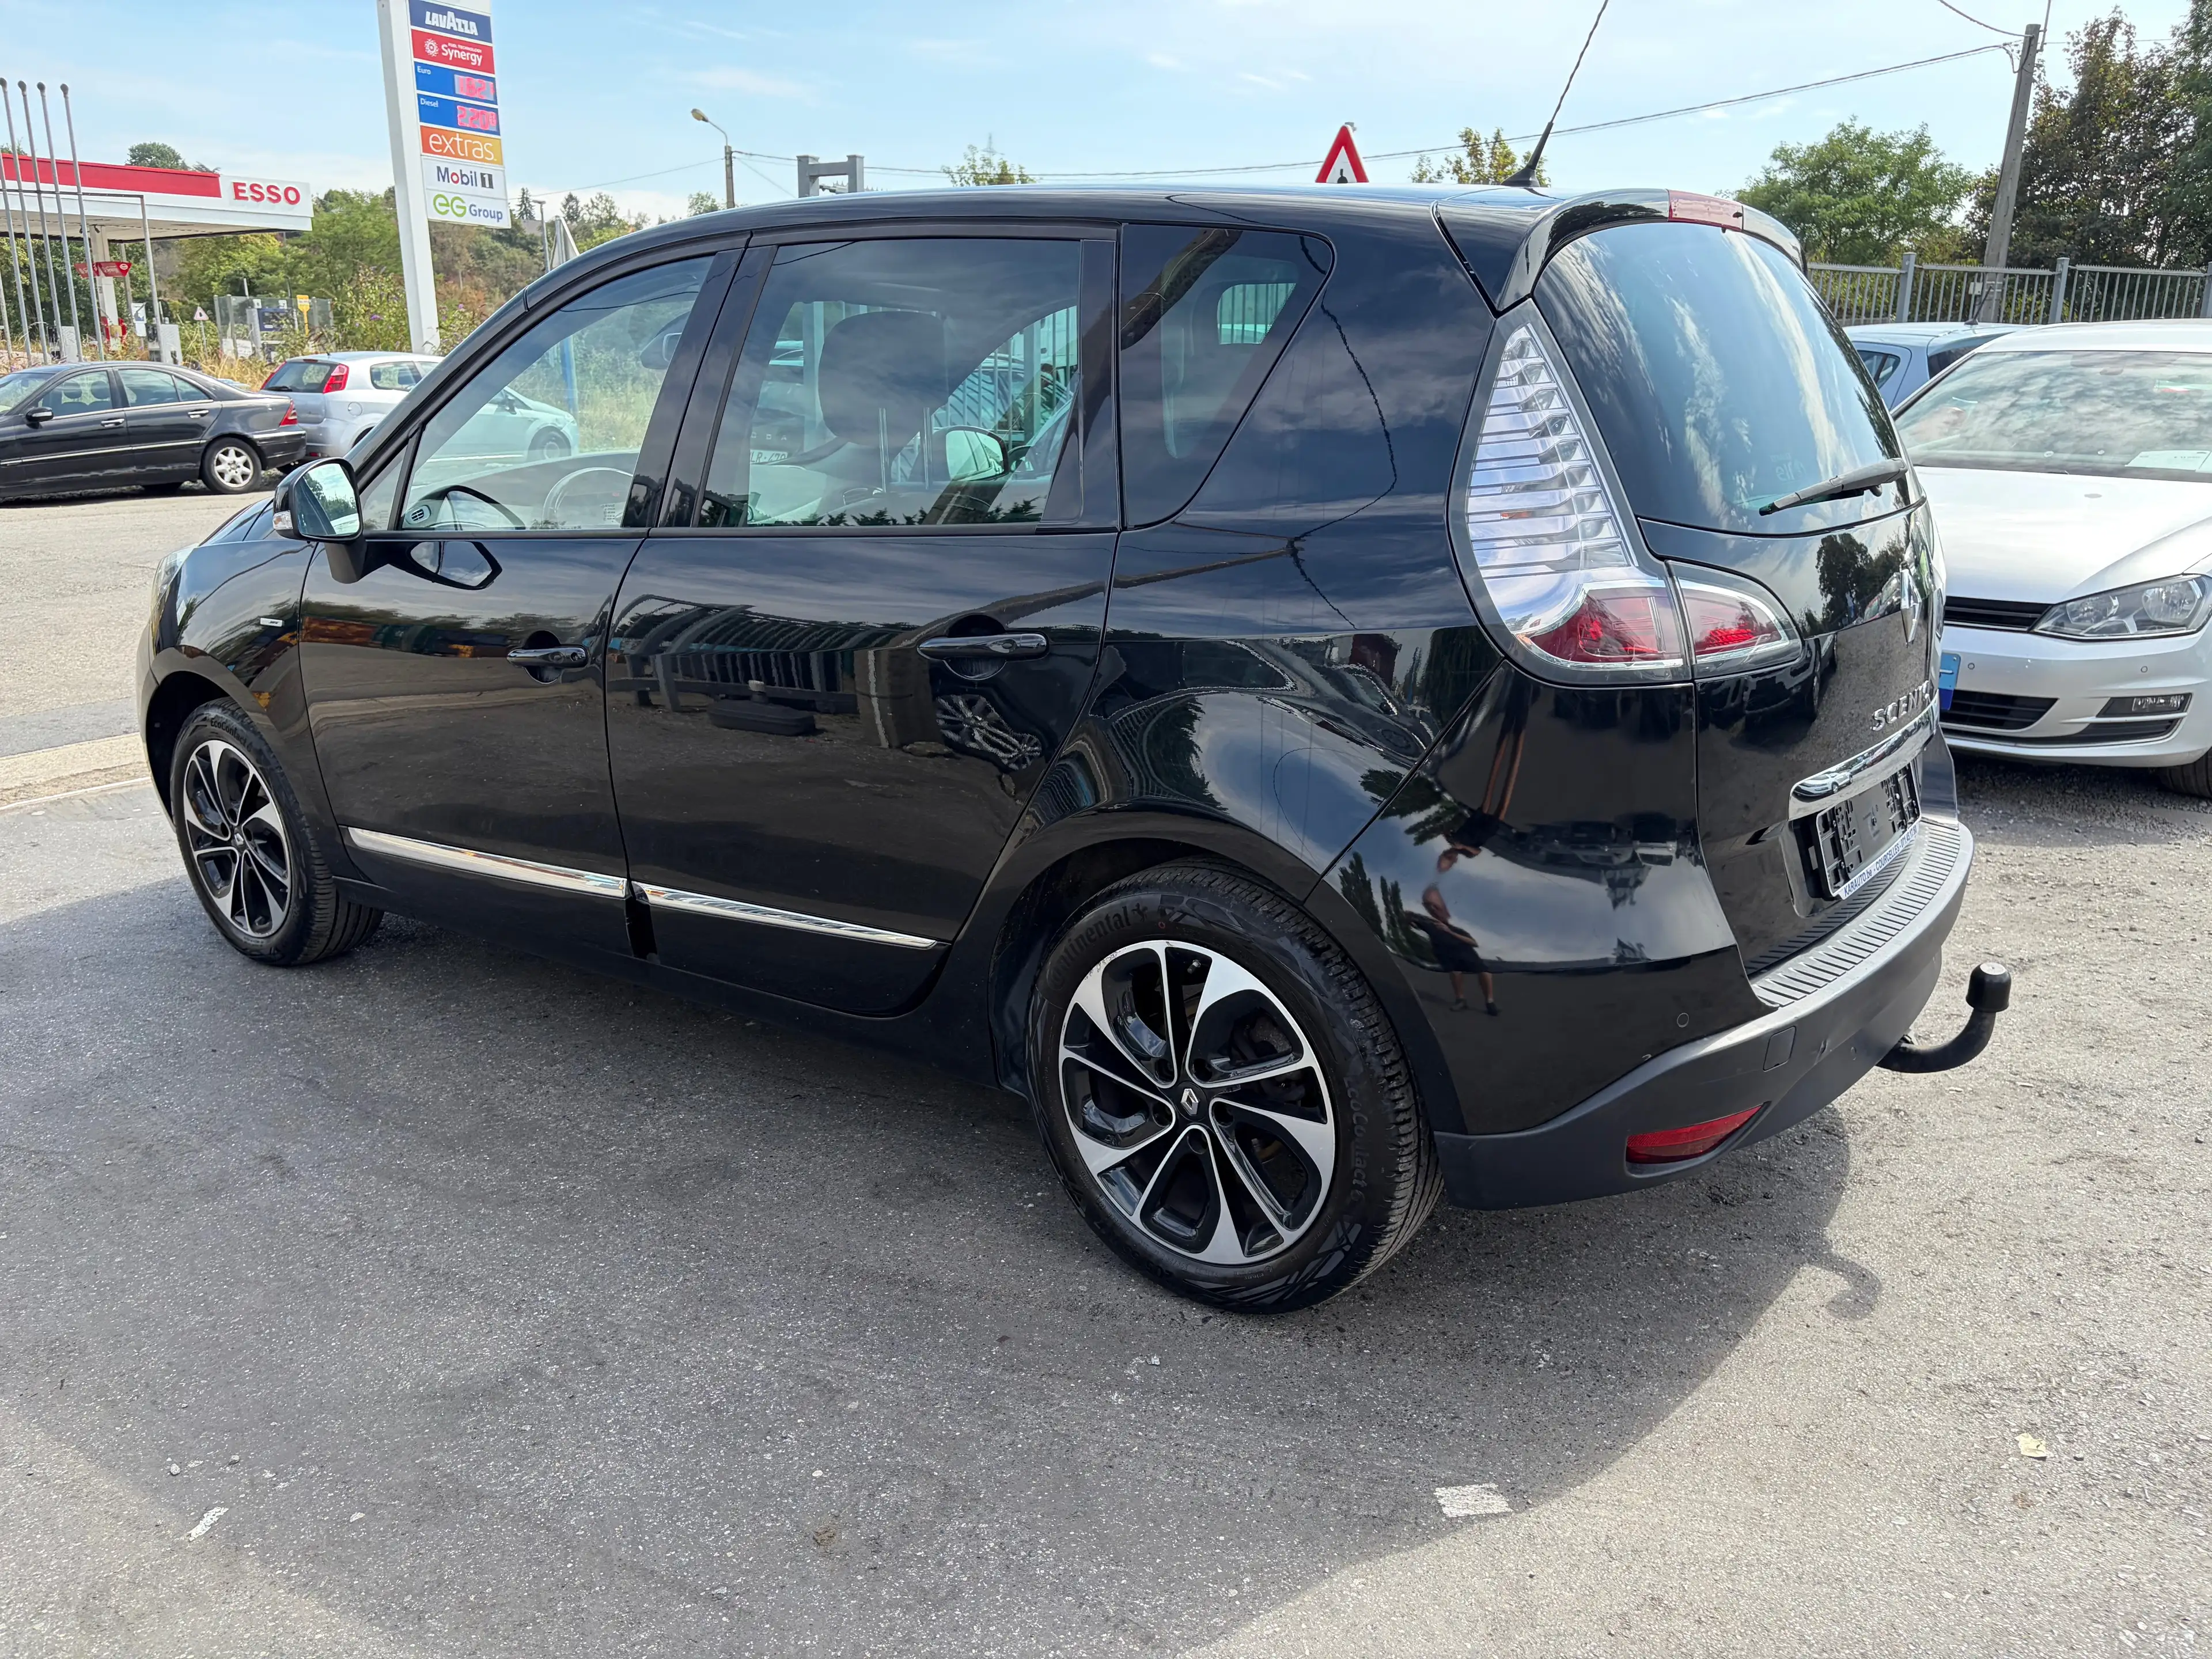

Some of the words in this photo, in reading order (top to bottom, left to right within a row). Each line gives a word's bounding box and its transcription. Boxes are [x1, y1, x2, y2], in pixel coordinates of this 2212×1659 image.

[425, 11, 478, 36] LAVAZZA
[441, 44, 482, 66] Synergy
[417, 66, 431, 74] Euro
[420, 98, 438, 107] Diesel
[429, 133, 494, 161] extras
[437, 165, 478, 187] Mobil
[233, 181, 300, 205] ESSO
[469, 203, 502, 222] Group
[1844, 869, 1872, 897] KARAUTO.be
[1875, 844, 1900, 872] COURCELLES
[1047, 905, 1131, 991] Continental
